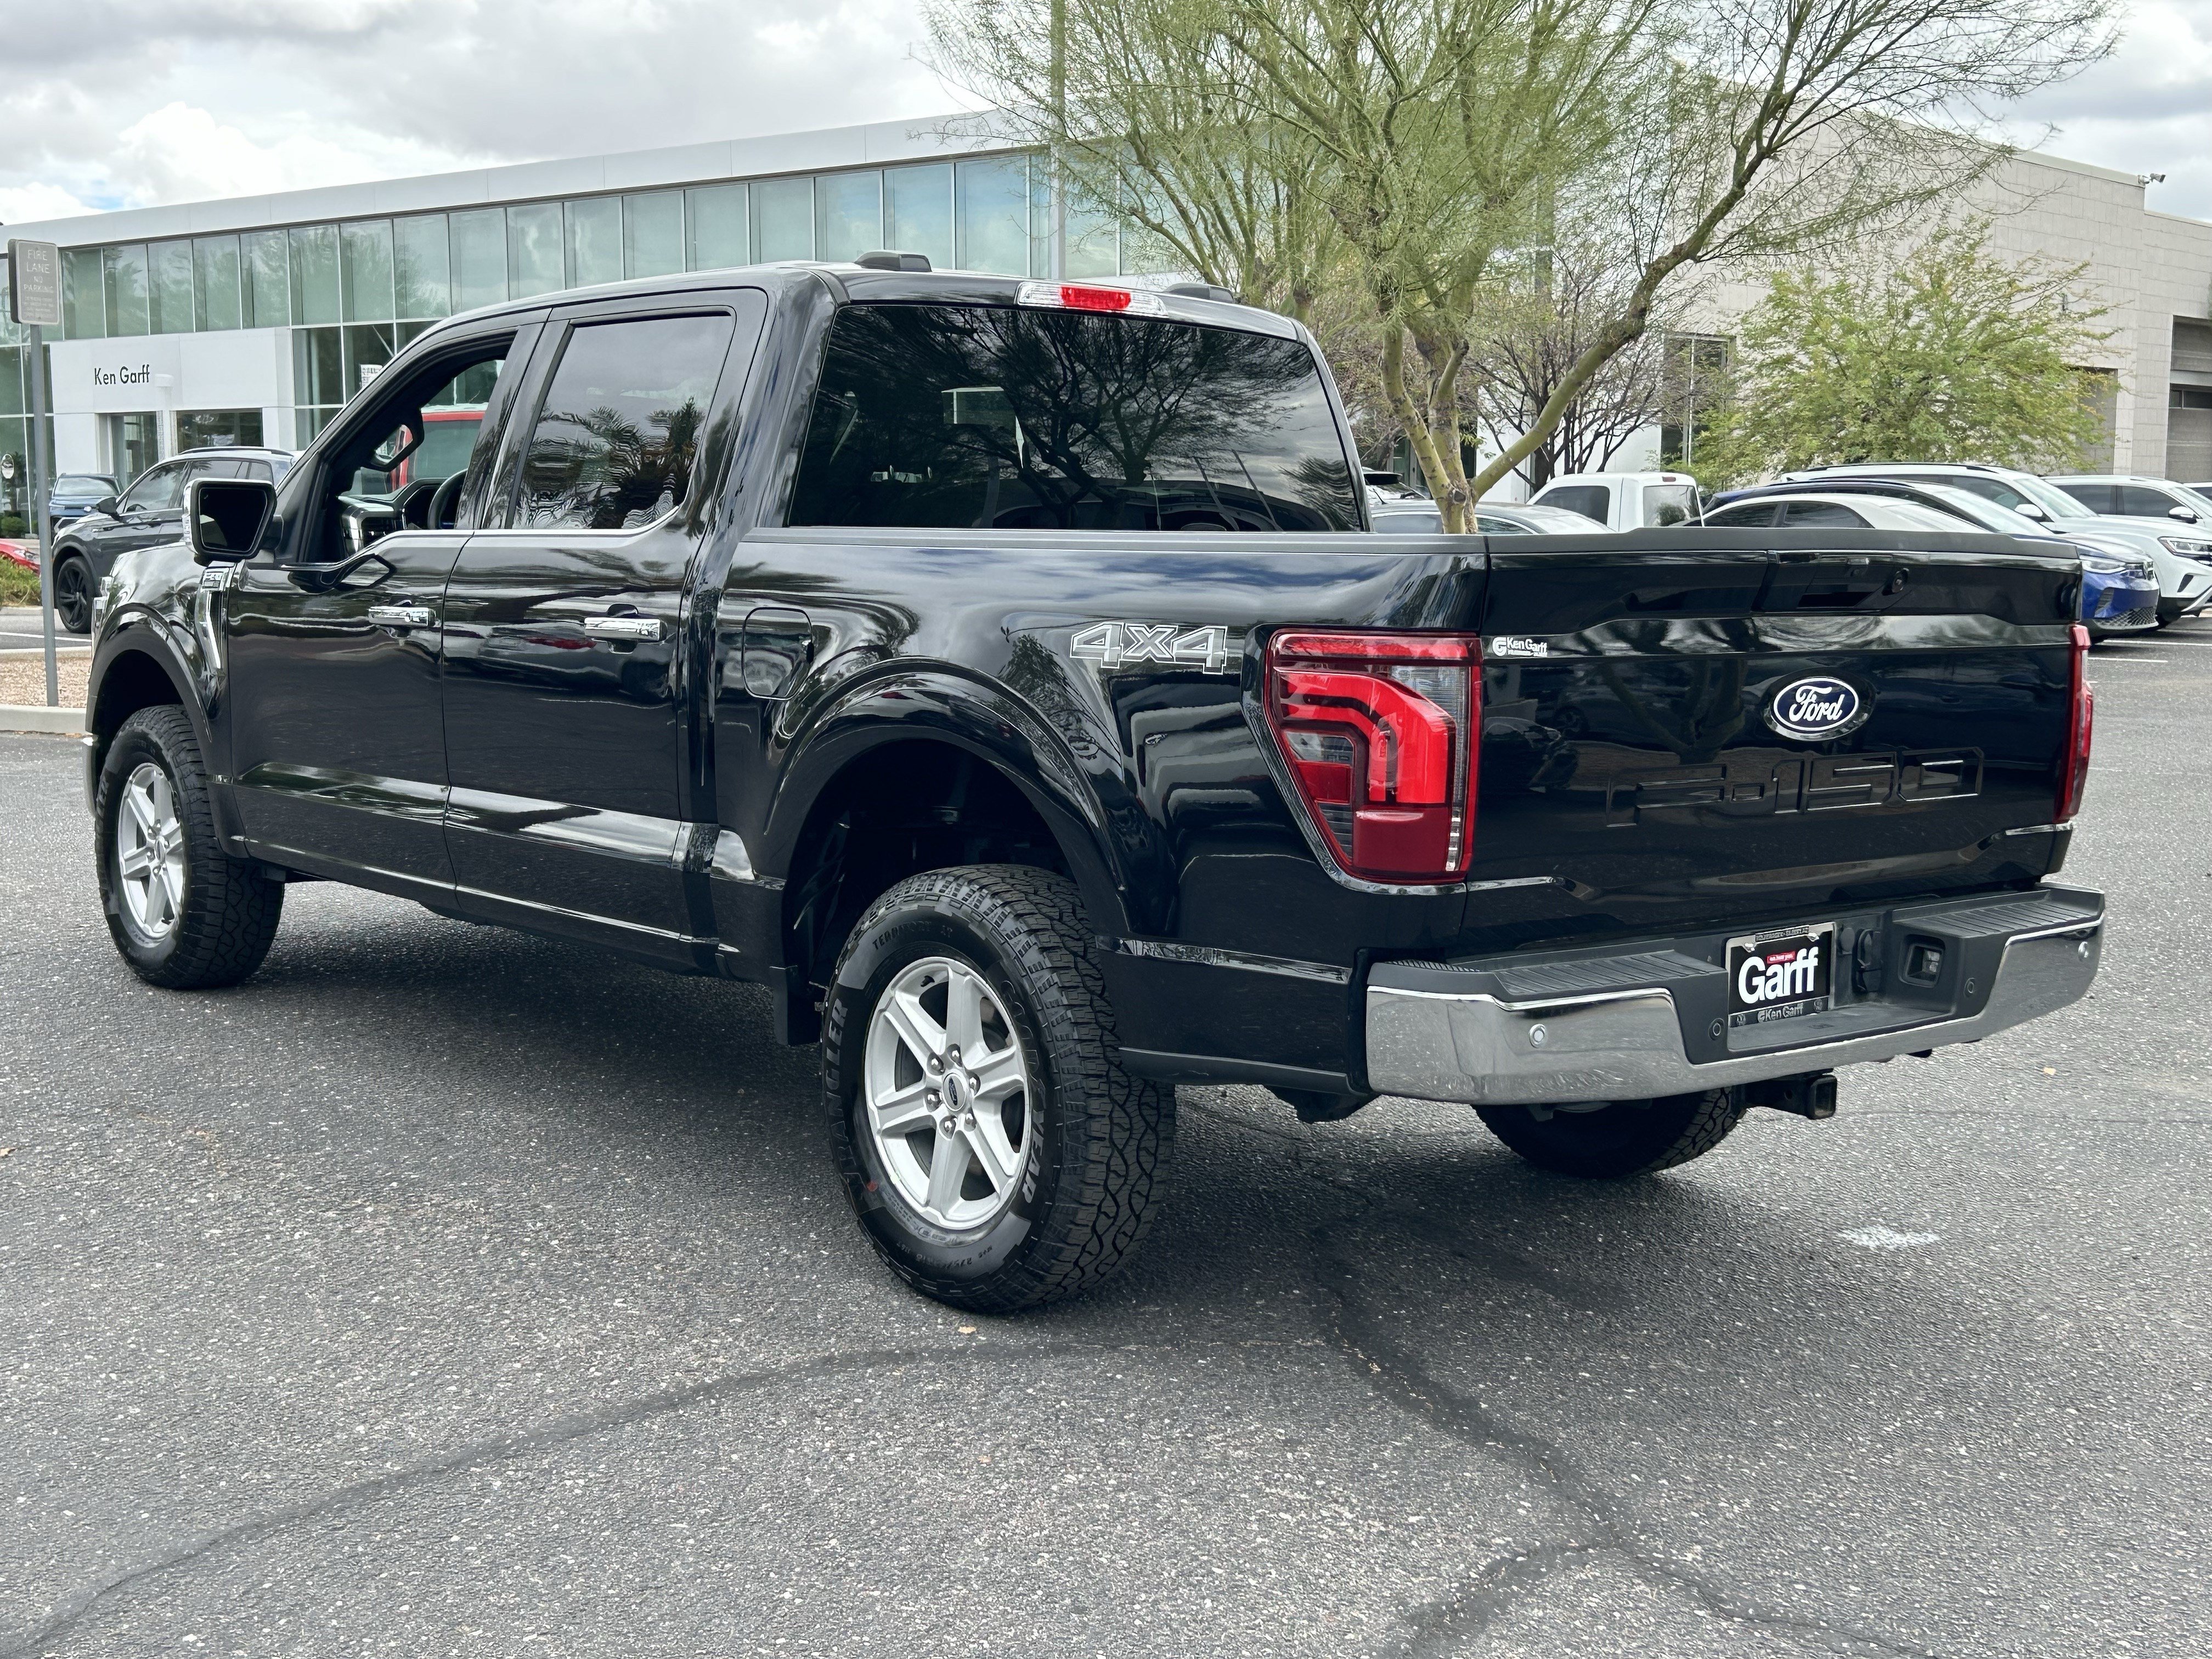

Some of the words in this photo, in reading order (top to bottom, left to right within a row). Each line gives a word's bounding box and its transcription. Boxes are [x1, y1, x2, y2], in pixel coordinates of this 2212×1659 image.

[28, 249, 48, 261] FIRE
[26, 262, 50, 274] LANE
[94, 368, 116, 385] Ken
[120, 364, 150, 384] Garff
[1506, 637, 1525, 650] Ken
[1525, 639, 1547, 653] Garff
[1788, 685, 1844, 723] Ford
[1738, 946, 1819, 1004] Garff
[1765, 1008, 1781, 1022] Ken
[1782, 1002, 1803, 1018] Garff
